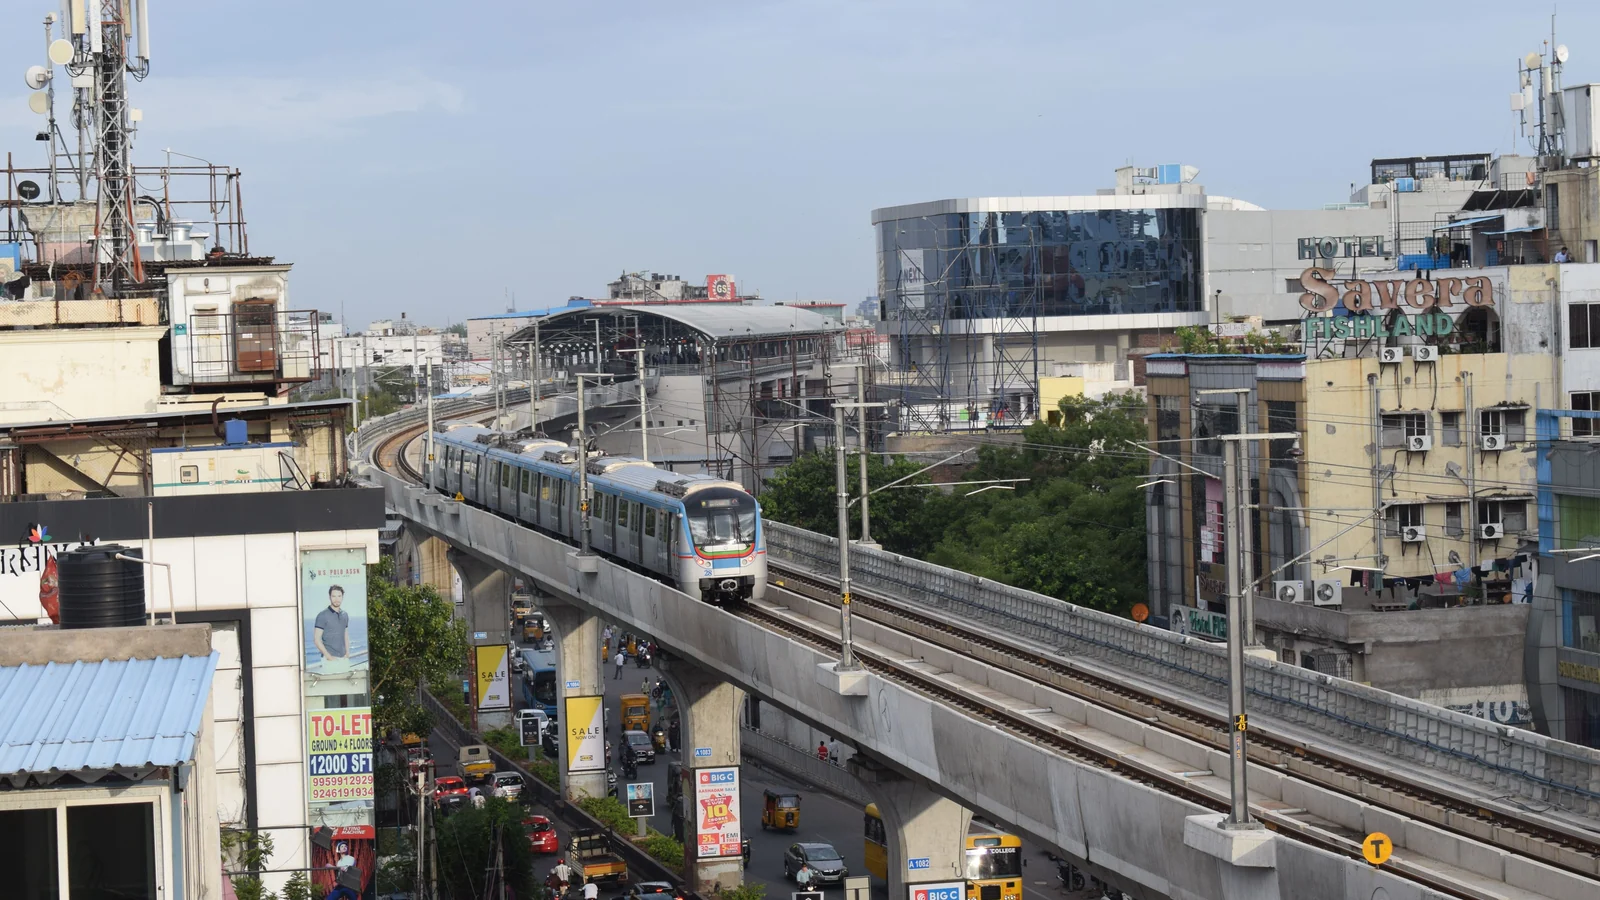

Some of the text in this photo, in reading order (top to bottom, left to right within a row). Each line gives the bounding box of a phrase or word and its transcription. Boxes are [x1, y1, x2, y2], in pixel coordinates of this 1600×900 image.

[1298, 235, 1392, 260] HOTEL
[1299, 267, 1495, 312] Savera
[1305, 313, 1453, 340] FISHLAND
[481, 671, 506, 679] SALE
[312, 714, 372, 736] TO-LET
[571, 727, 600, 736] SALE
[312, 739, 337, 751] GROUND
[344, 739, 348, 750] 4
[350, 738, 373, 750] FLOORS
[311, 754, 373, 774] 12000 SFT
[313, 775, 374, 787] 9959912929
[711, 773, 726, 782] BIG
[313, 787, 374, 798] 9246191934
[706, 804, 728, 819] 10
[1371, 840, 1384, 858] T
[909, 860, 914, 868] A
[929, 891, 957, 900] BIG C
